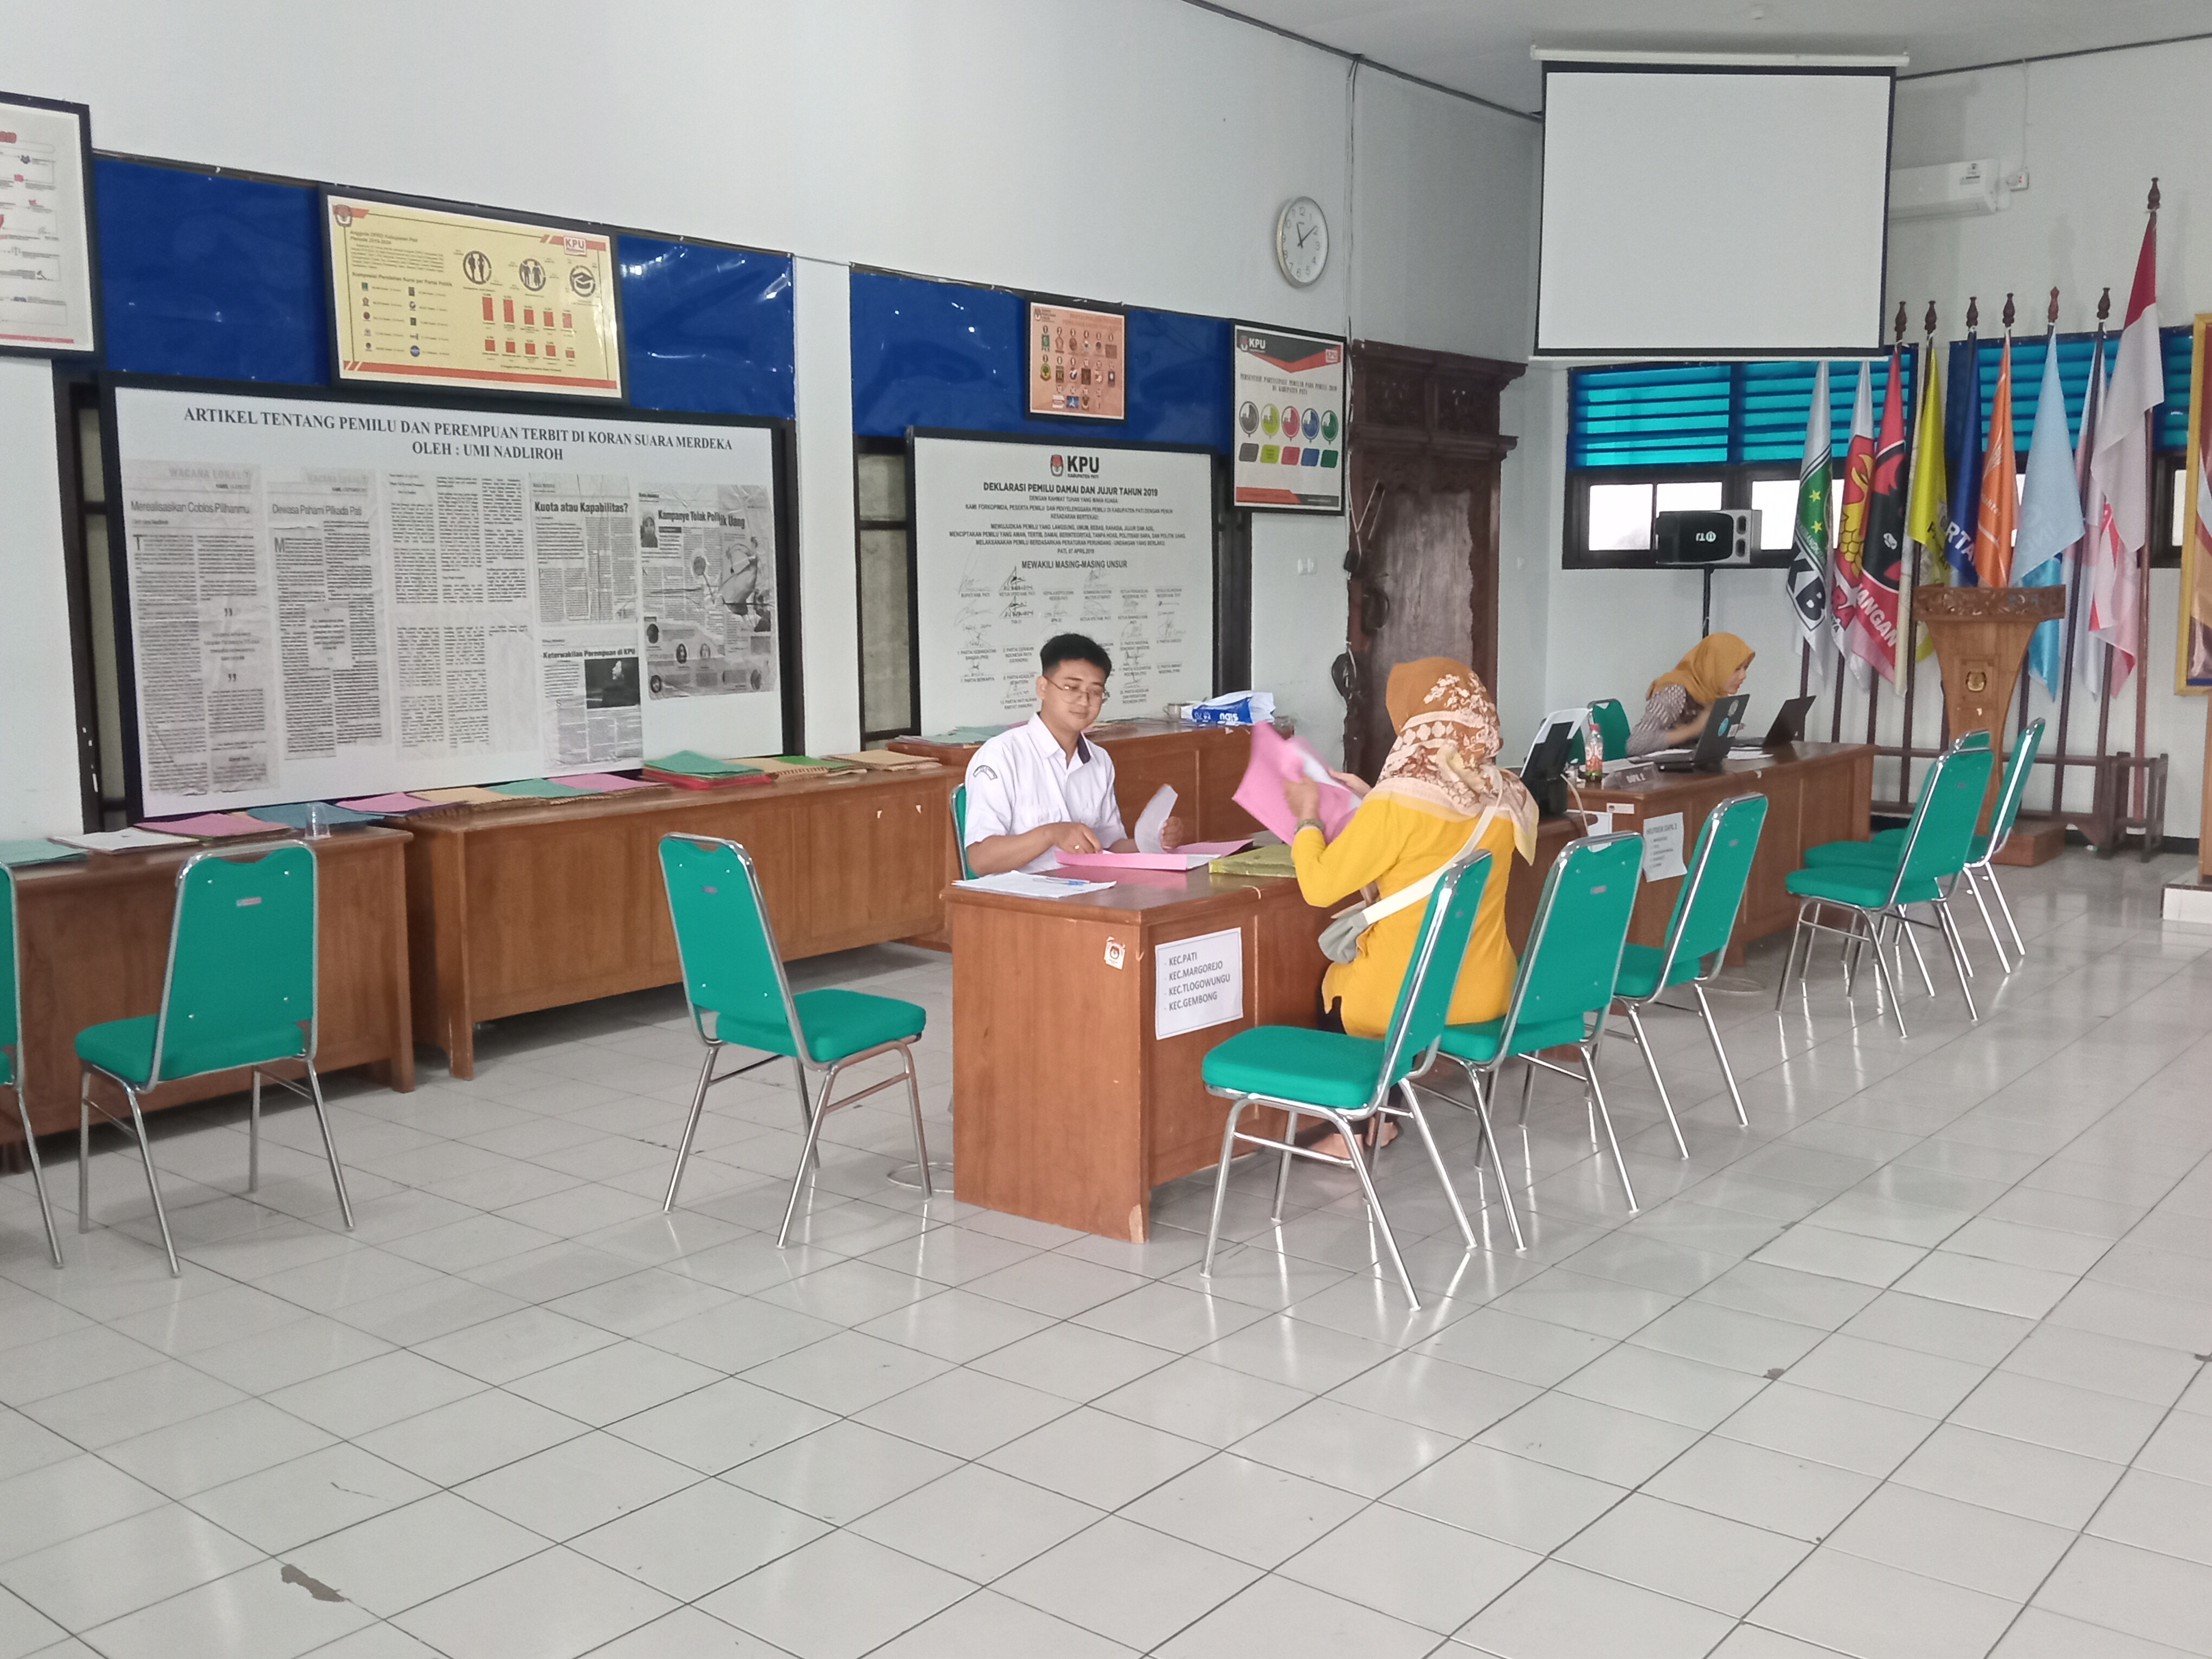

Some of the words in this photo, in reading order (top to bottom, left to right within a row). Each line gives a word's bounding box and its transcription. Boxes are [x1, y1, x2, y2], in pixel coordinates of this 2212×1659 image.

[1300, 207, 1305, 216] 12
[1313, 226, 1318, 235] 2
[565, 238, 584, 249] KPU
[1316, 241, 1320, 250] 3
[1289, 262, 1293, 271] 7
[1297, 268, 1301, 277] 6
[1306, 266, 1310, 275] 5
[1249, 338, 1265, 349] KPU
[184, 407, 258, 425] ARTIKEL
[261, 411, 335, 429] TENTANG
[339, 416, 396, 433] PEMILU
[401, 420, 430, 434] DAN
[434, 423, 519, 440] PEREMPUAN
[522, 427, 568, 442] TERBIT
[571, 430, 586, 443] DI
[589, 432, 632, 445] KORAN
[635, 434, 674, 447] SUARA
[676, 436, 732, 451] MERDEKA
[412, 441, 451, 456] OLEH
[464, 443, 490, 458] UMI
[493, 446, 563, 461] NADLIROH
[1067, 455, 1099, 473] KPU
[983, 482, 1026, 492] DEKLARASI
[1028, 483, 1054, 493] PEMILU
[1056, 485, 1079, 494] DAMAI
[1081, 485, 1095, 494] DAN
[1097, 486, 1118, 496] JUJUR
[1119, 487, 1142, 496] TAHUN
[1143, 488, 1158, 497] 2019
[131, 500, 186, 512] Merealisasikan
[188, 501, 214, 513] Coblos
[215, 503, 250, 514] Pilihanmu
[272, 504, 299, 515] Dewasa
[300, 505, 324, 515] Pahami
[325, 505, 349, 516] Pilkada
[350, 506, 362, 516] Pati
[535, 501, 559, 512] Kuota
[560, 503, 578, 512] atau
[580, 502, 628, 514] Kapabilitas?
[658, 510, 690, 523] Kampanye
[690, 511, 706, 522] Tolak
[707, 512, 728, 526] Politik
[728, 515, 745, 529] Uang
[1021, 560, 1054, 569] MEWAKILI
[1055, 560, 1105, 569] MASING-MASING
[1106, 560, 1128, 568] UNSUR
[543, 651, 583, 659] Keterwakilan
[584, 649, 616, 657] Perempuan
[1168, 952, 1197, 967] KEC.PATI
[1168, 960, 1223, 981] KEC.MARGOREJO
[1168, 974, 1231, 996] KEC.TLOGOWUNGU
[1168, 991, 1218, 1012] KEC.GEMBONG
